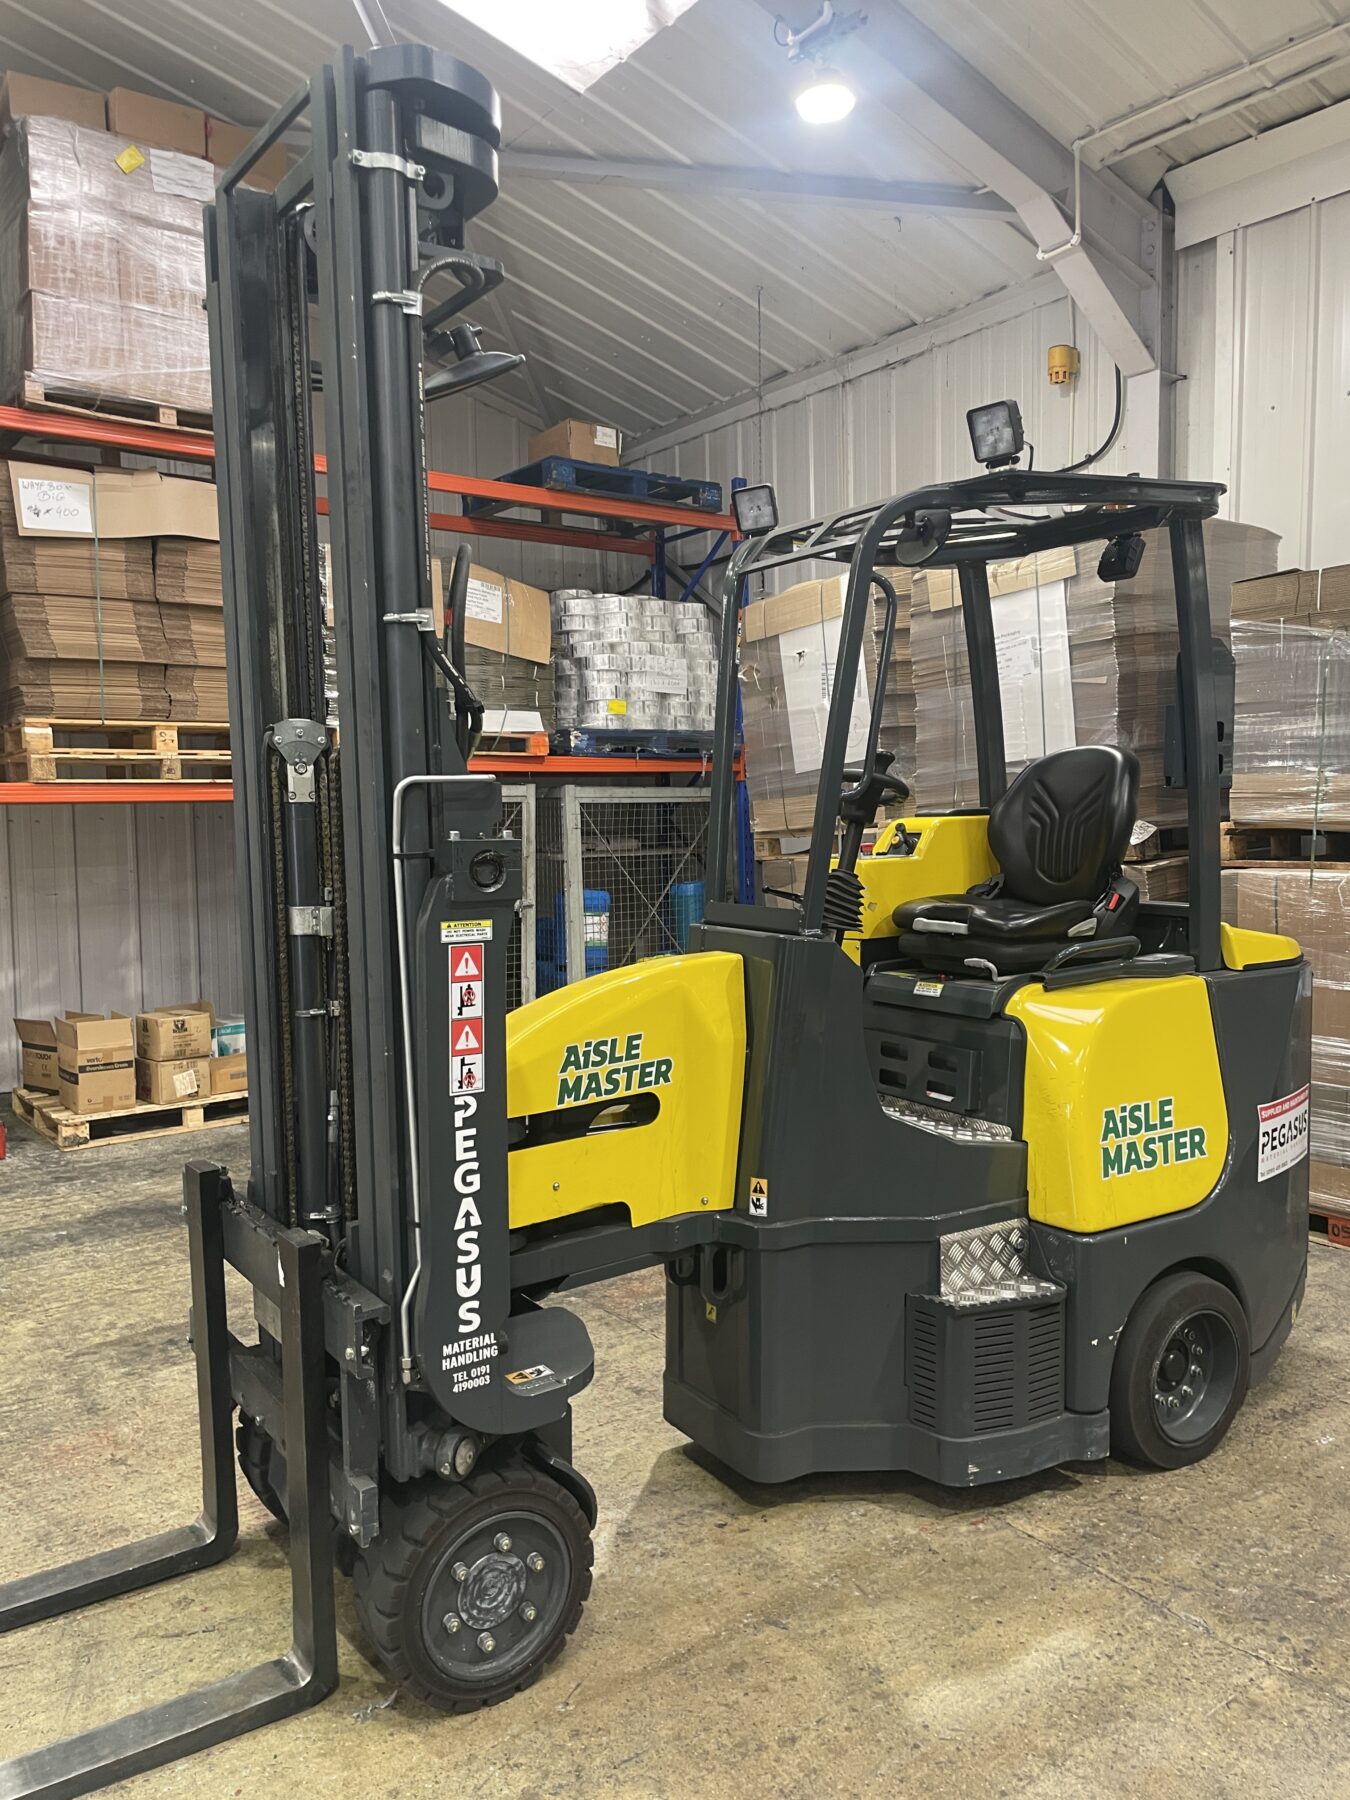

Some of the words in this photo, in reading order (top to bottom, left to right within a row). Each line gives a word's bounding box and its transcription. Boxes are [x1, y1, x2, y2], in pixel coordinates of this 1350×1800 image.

[557, 1058, 672, 1106] MASTER
[1261, 1110, 1307, 1155] PEGASUS
[1102, 1127, 1206, 1178] MASTER
[453, 1095, 482, 1333] PEGASUS
[442, 1332, 497, 1357] MATERIAL
[442, 1345, 499, 1371] HANDLING
[452, 1371, 469, 1383] TEL
[470, 1364, 490, 1378] 0191
[452, 1375, 490, 1393] 4190003
